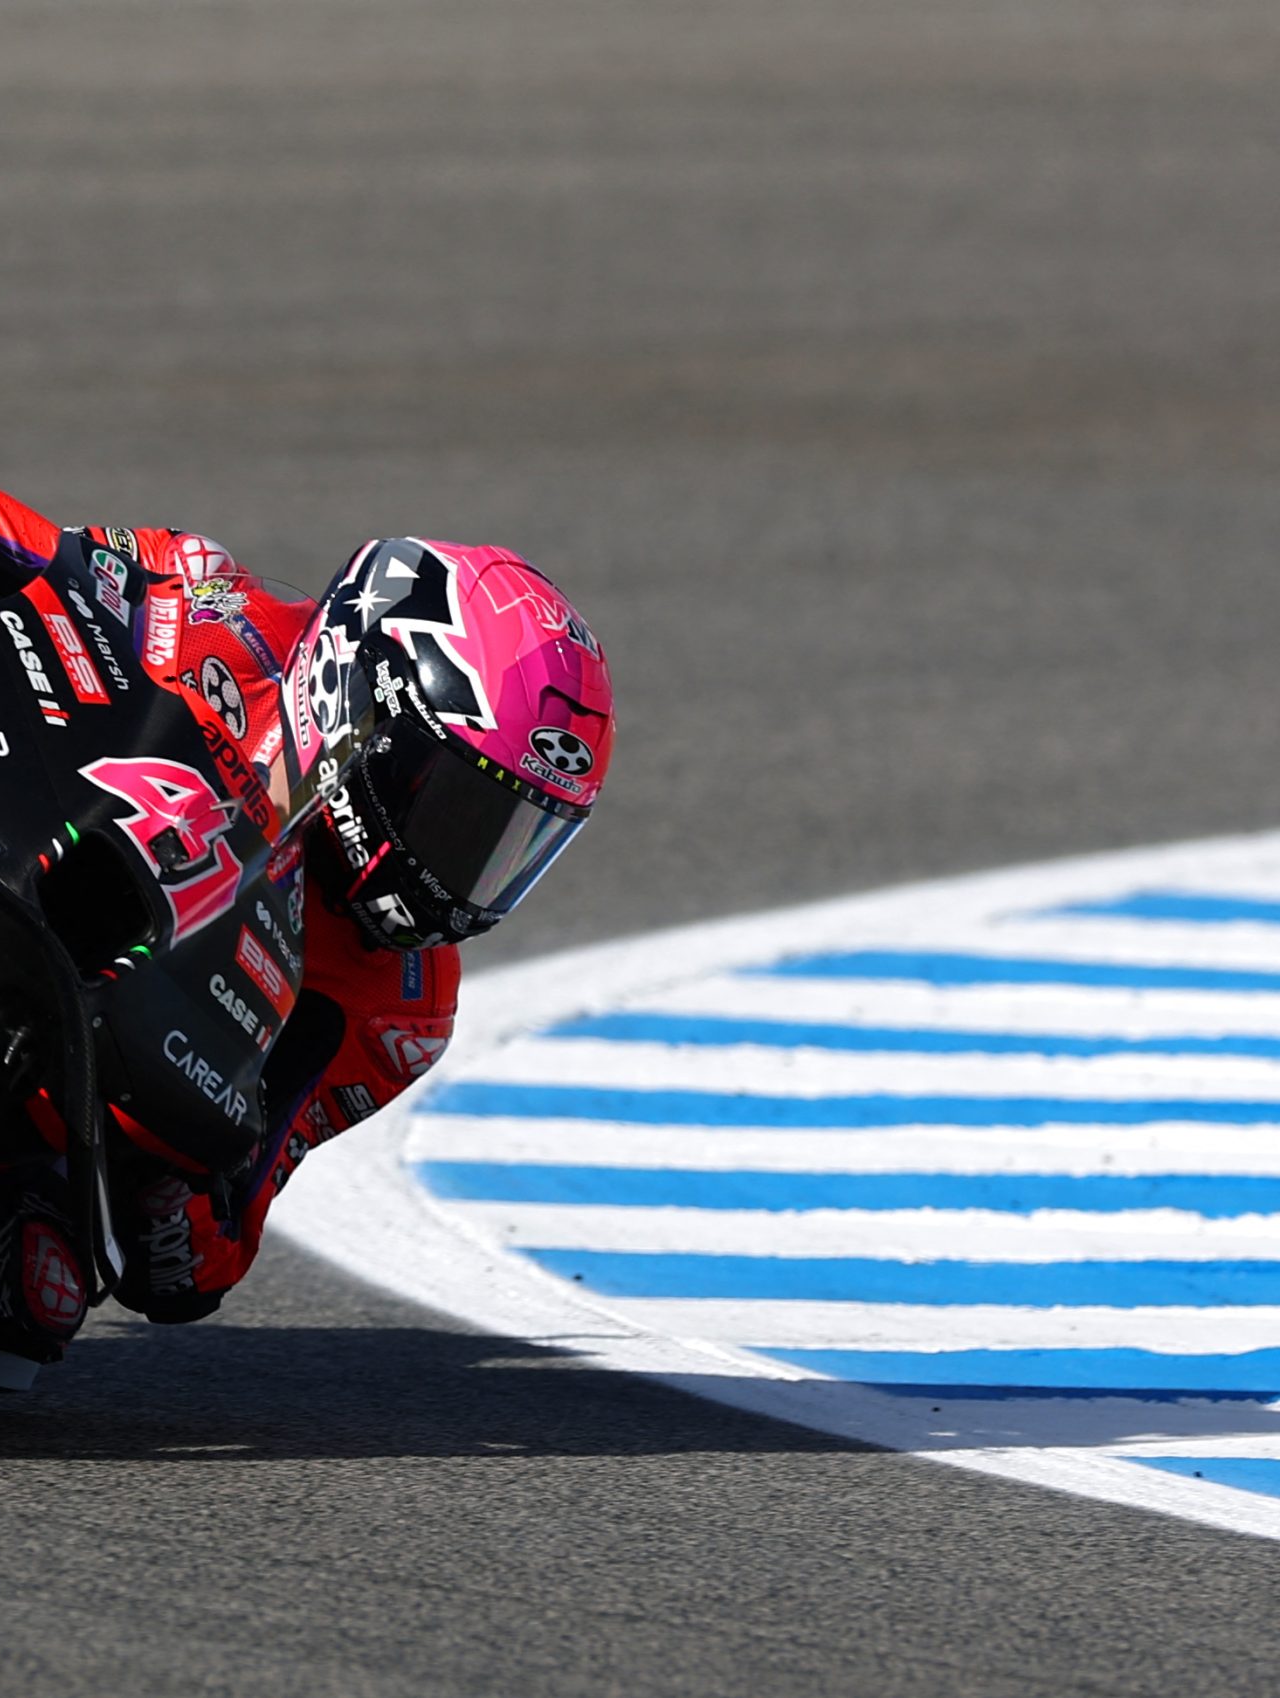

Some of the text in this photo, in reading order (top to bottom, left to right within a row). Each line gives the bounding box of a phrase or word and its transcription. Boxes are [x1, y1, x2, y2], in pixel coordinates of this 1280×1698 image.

[0, 610, 54, 694] CASE
[49, 613, 104, 698] BS
[87, 623, 130, 691] Marsh
[198, 719, 270, 830] aprilia
[317, 758, 370, 869] aprilia
[520, 753, 582, 795] Kabuto
[209, 974, 259, 1035] CASE
[241, 932, 281, 996] BS
[163, 1030, 248, 1126] CAREAR
